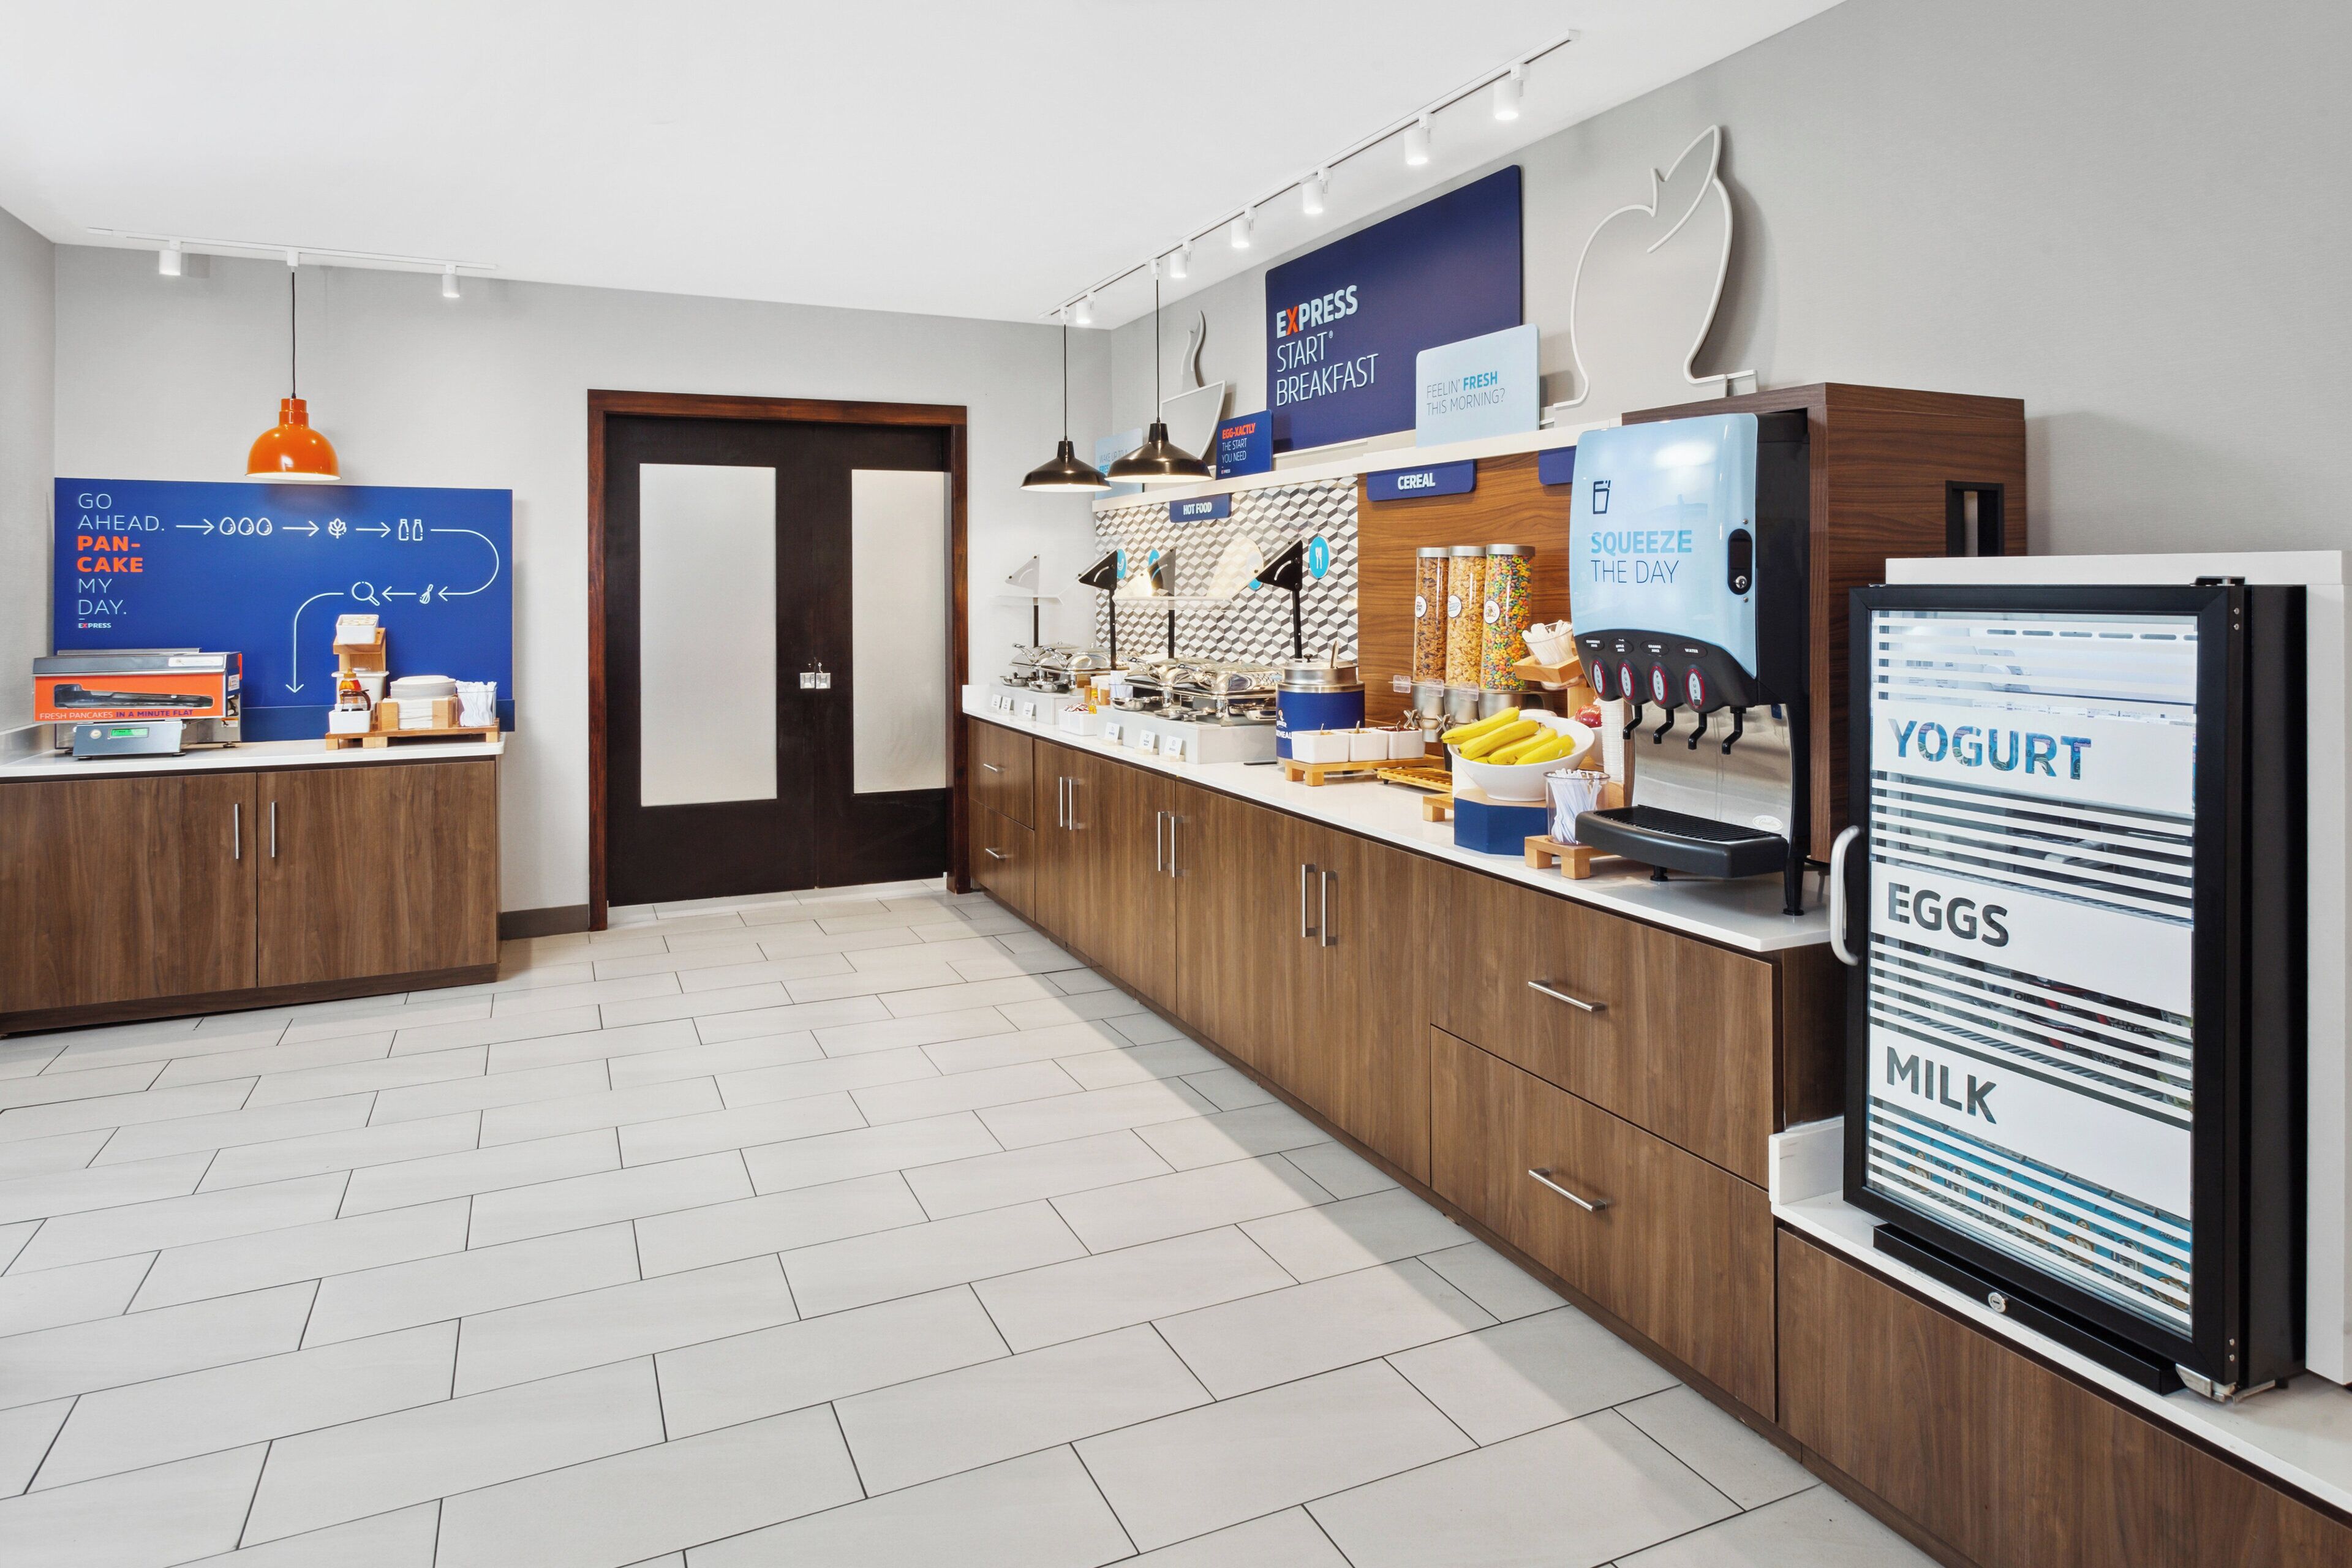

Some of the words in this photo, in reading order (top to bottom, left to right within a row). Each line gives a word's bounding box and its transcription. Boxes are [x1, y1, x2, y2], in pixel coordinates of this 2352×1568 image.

[1276, 284, 1359, 339] EXPRESS
[1276, 353, 1379, 407] BREAKFAST
[1463, 371, 1498, 391] FRESH
[1426, 399, 1447, 416] THIS
[1450, 387, 1506, 412] MORNING?
[1221, 422, 1256, 440] EGG-XACTLY
[1221, 440, 1232, 451] THE
[1232, 437, 1248, 450] START
[1221, 453, 1232, 464] YOU
[1233, 450, 1246, 462] NEED
[1397, 472, 1436, 491] CEREAL
[78, 492, 112, 510] GO
[1183, 503, 1195, 515] HOT
[1196, 502, 1213, 514] FOOD
[77, 514, 165, 531] AHEAD.
[77, 535, 141, 552] PAN-
[1591, 529, 1692, 557] SQUEEZE
[77, 556, 144, 573] CAKE
[1590, 560, 1627, 584] THE
[1635, 560, 1679, 584] DAY
[78, 578, 113, 594] MY
[78, 599, 127, 615] DAY.
[1887, 718, 2092, 780] YOGURT
[1888, 881, 2009, 948] EGGS
[1887, 1046, 1997, 1125] MILK
